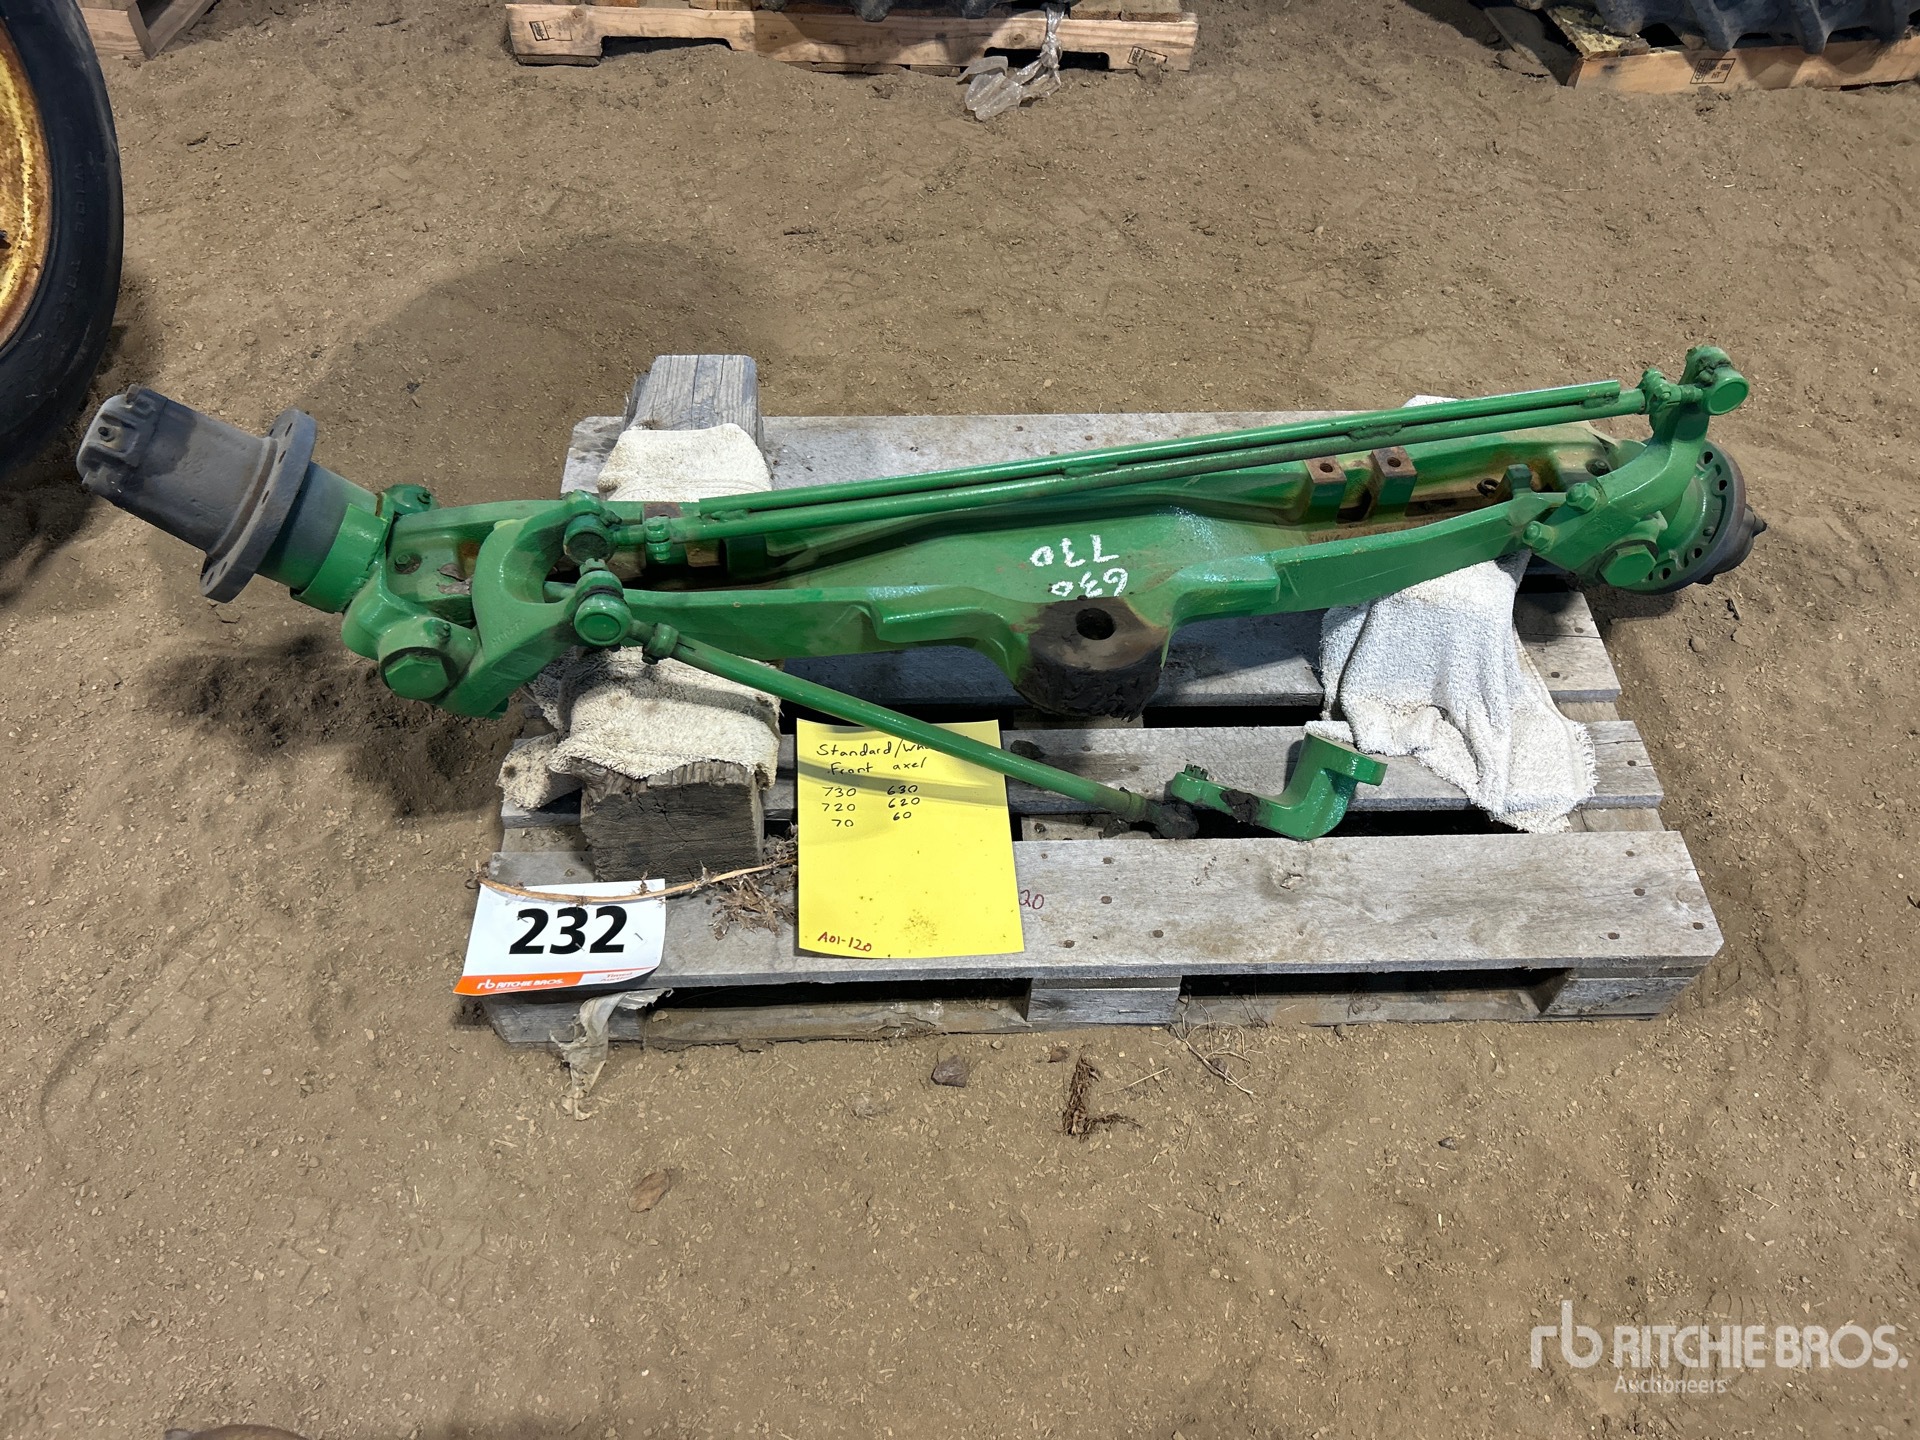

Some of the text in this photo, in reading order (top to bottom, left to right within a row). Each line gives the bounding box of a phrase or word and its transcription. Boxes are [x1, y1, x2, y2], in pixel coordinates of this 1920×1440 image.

[1029, 534, 1119, 567] 730
[1051, 568, 1128, 597] 630
[816, 738, 929, 758] Standard/Wh
[830, 757, 927, 775] Front axel
[822, 785, 918, 797] 730 630
[821, 797, 920, 811] 720 620
[831, 811, 912, 827] 70 60
[1019, 889, 1045, 910] 20
[509, 905, 628, 955] 232
[817, 931, 872, 952] A01-120
[477, 979, 496, 990] rb
[496, 981, 533, 989] RITCHIE
